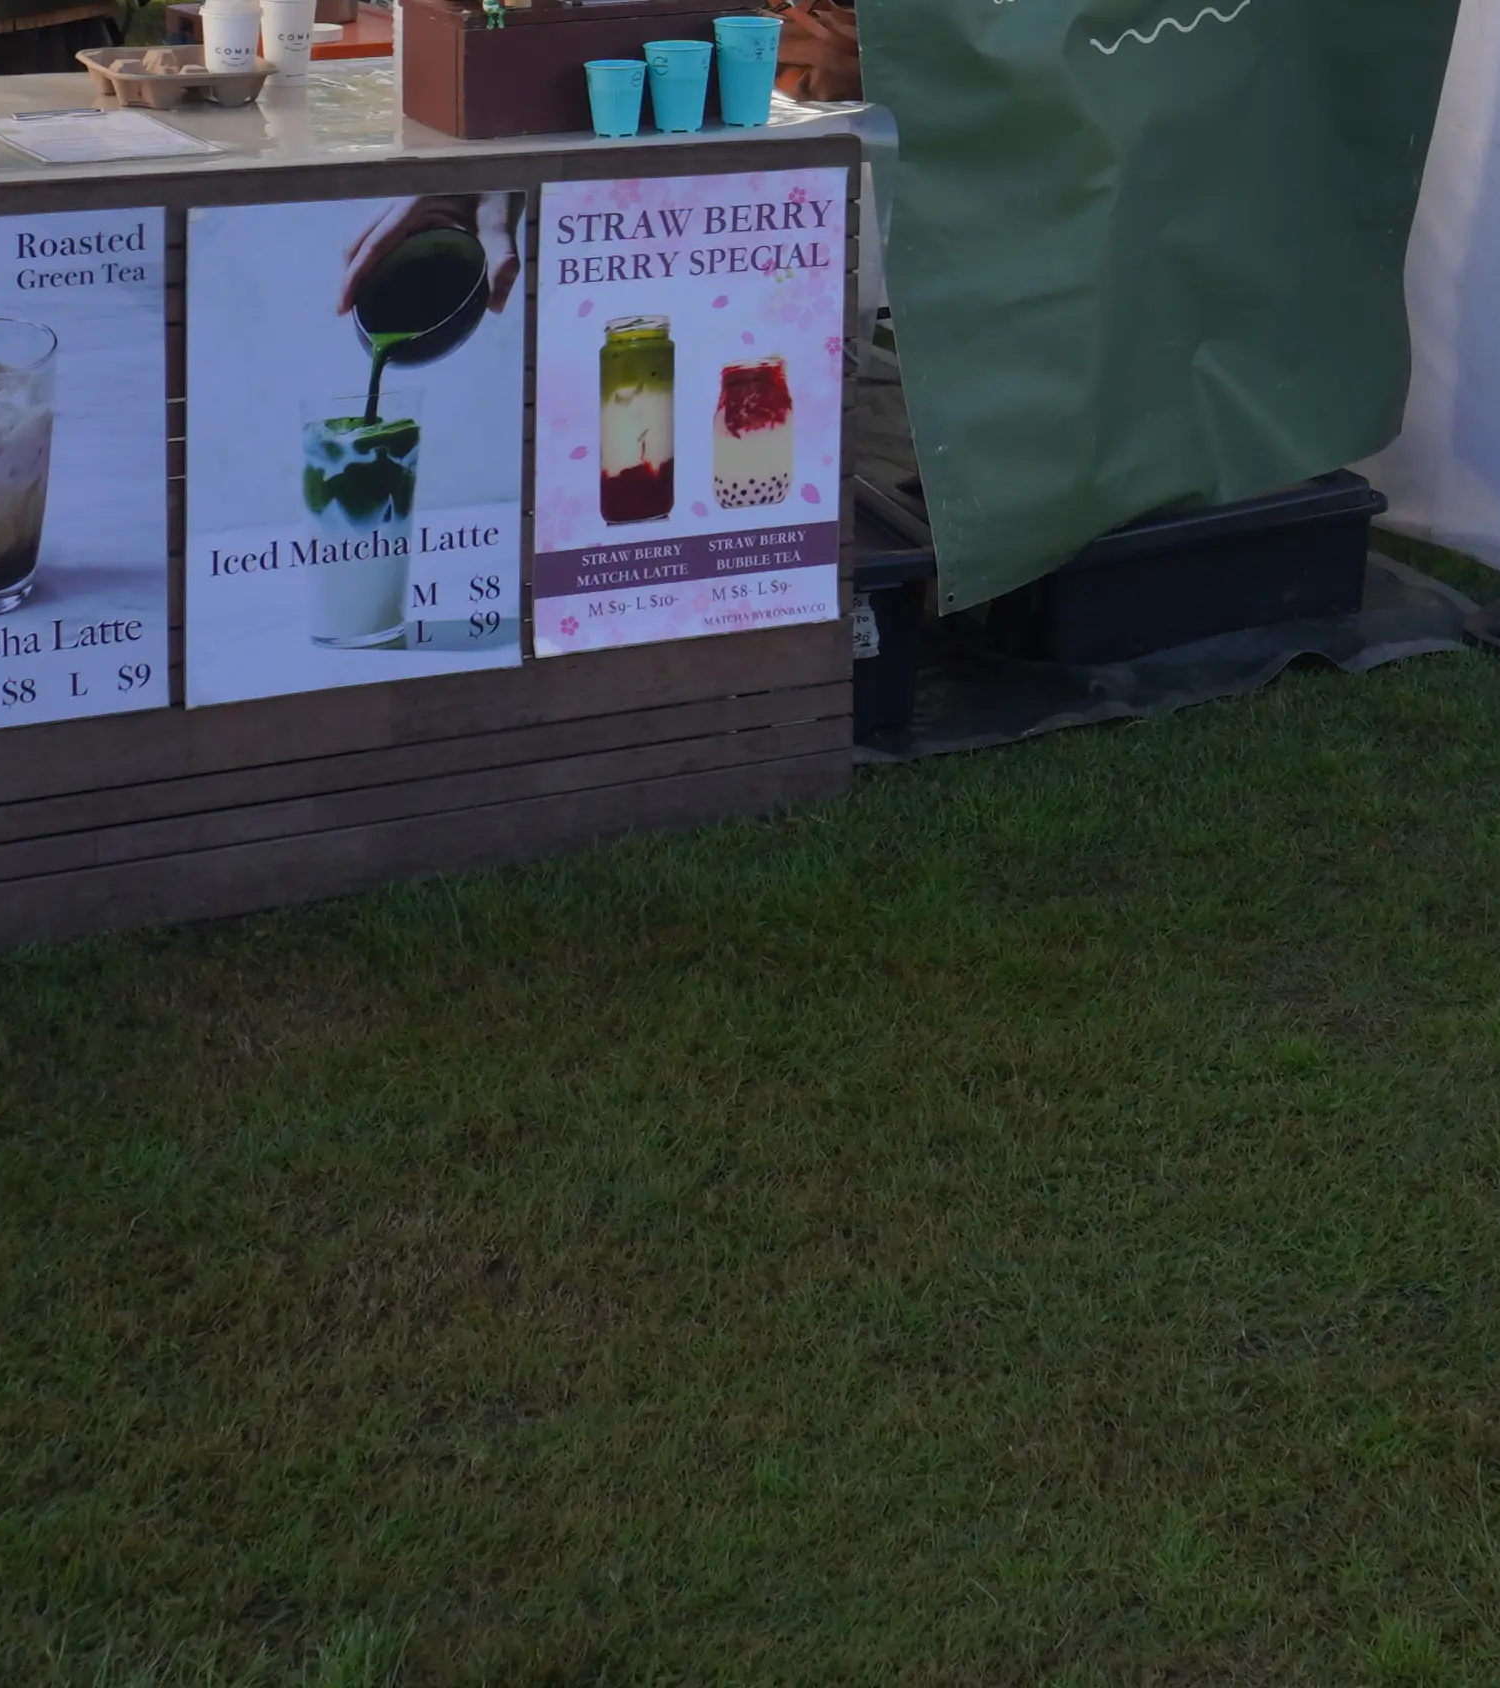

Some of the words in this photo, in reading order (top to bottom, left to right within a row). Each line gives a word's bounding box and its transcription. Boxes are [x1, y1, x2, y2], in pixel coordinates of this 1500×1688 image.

[556, 208, 693, 245] STRAW
[703, 200, 833, 235] BERRY
[16, 223, 146, 260] Roasted
[16, 268, 94, 290] Green
[102, 262, 146, 284] Tea
[558, 251, 681, 285] BERRY
[689, 242, 829, 276] SPECIAL
[210, 541, 278, 577] Iced
[289, 533, 410, 568] Matcha
[419, 524, 499, 553] Latte
[582, 550, 632, 566] STRAW
[634, 544, 683, 561] BERRY
[708, 535, 757, 552] STRAW
[760, 530, 806, 546] BERRY
[576, 569, 640, 587] MATCHA
[643, 563, 689, 579] LATTE
[716, 554, 772, 571] BUBBLE
[774, 550, 801, 564] TEA
[411, 581, 438, 609] M
[468, 574, 501, 603] $8
[588, 602, 603, 618] M
[636, 596, 646, 610] L
[712, 586, 726, 603] M
[758, 582, 767, 596] L
[52, 617, 143, 651] Latte
[415, 620, 433, 644] L
[468, 610, 501, 639] $9
[1, 678, 37, 708] $8
[71, 672, 88, 697] L
[117, 663, 151, 692] $9
